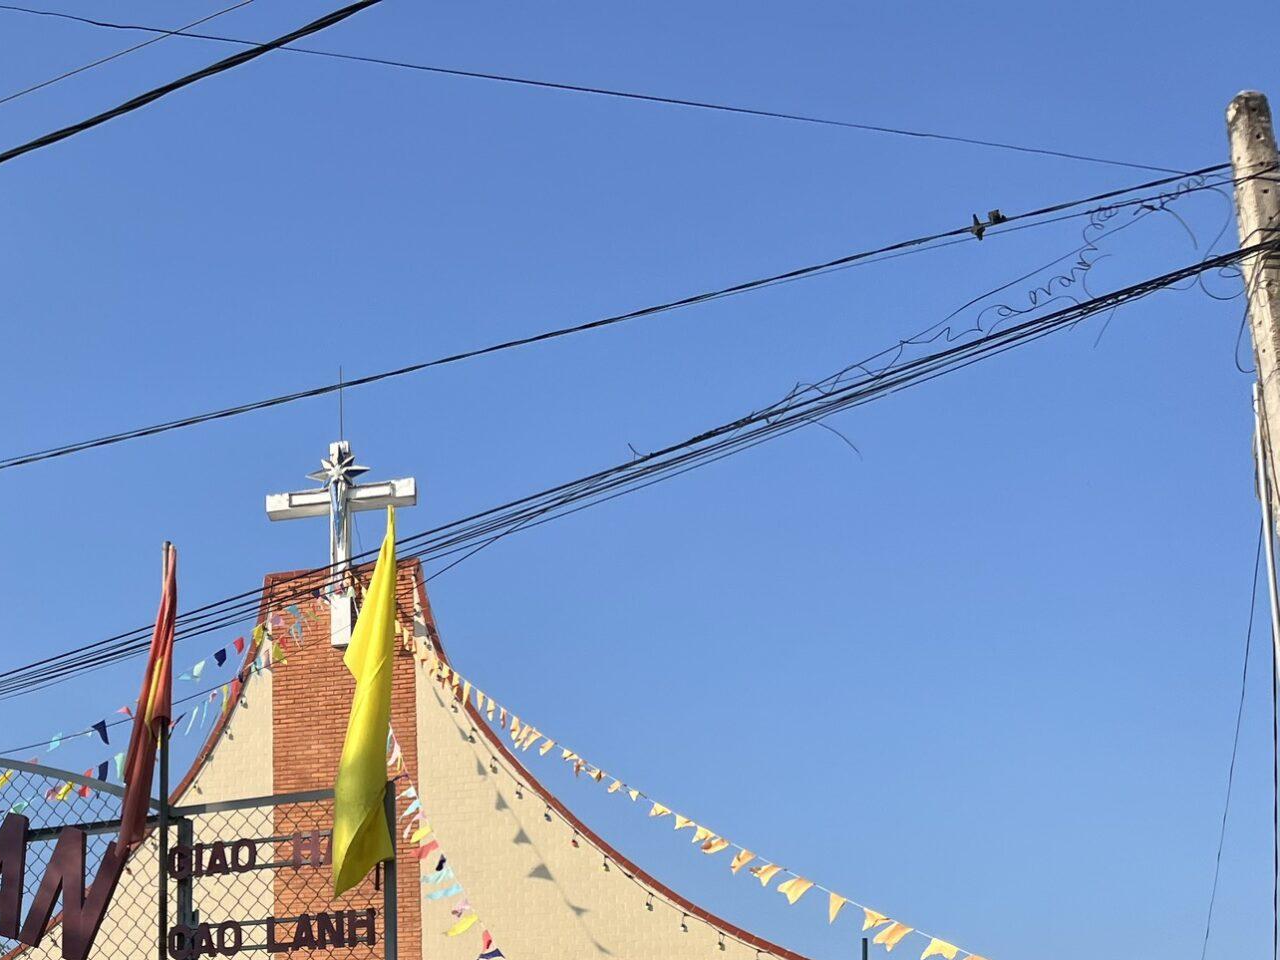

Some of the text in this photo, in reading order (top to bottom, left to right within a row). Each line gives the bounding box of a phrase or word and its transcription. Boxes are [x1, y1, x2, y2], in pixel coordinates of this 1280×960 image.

[168, 838, 258, 880] GIAO
[168, 907, 377, 960] CAO LANH
